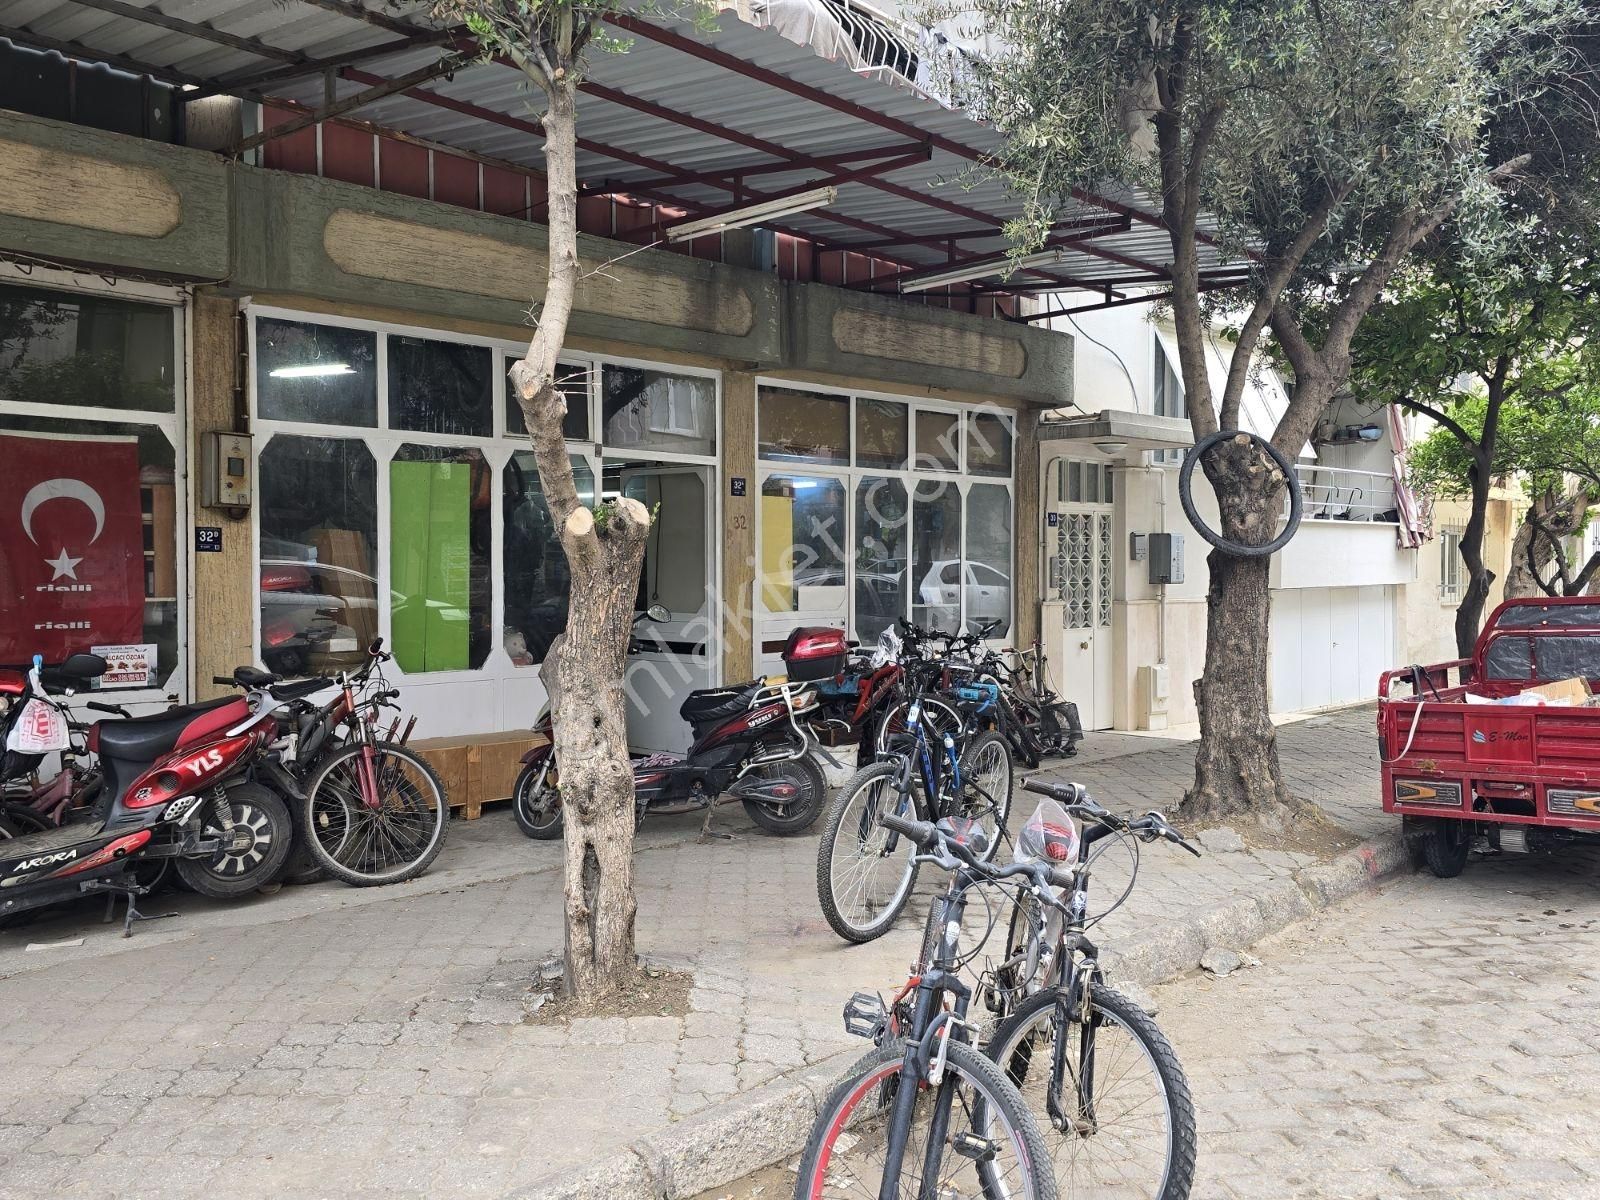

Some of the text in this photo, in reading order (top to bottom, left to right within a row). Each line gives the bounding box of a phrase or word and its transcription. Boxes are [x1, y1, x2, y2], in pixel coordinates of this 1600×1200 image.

[733, 514, 747, 530] 32
[185, 749, 223, 777] YLS
[13, 849, 77, 872] ARORA
